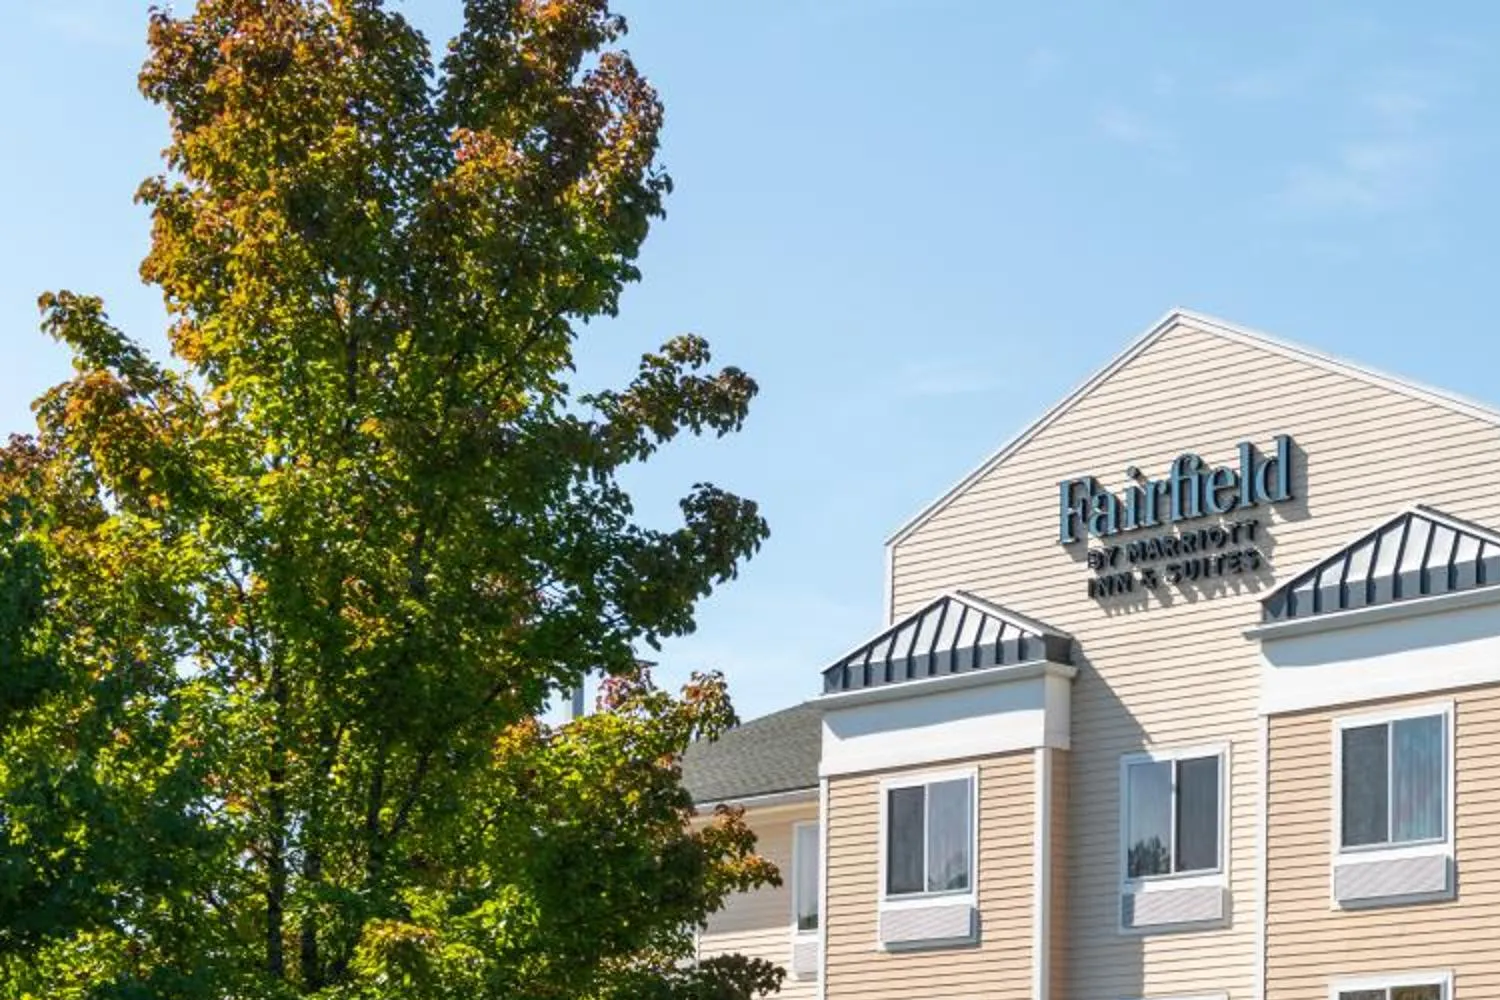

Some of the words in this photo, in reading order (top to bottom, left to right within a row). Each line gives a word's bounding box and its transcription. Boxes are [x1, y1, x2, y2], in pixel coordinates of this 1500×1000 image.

[1057, 433, 1294, 544] Fairfield
[1088, 546, 1123, 570] BY
[1126, 519, 1259, 563] MARRIOTT
[1088, 571, 1133, 598] INN
[1166, 549, 1260, 584] SUITES
